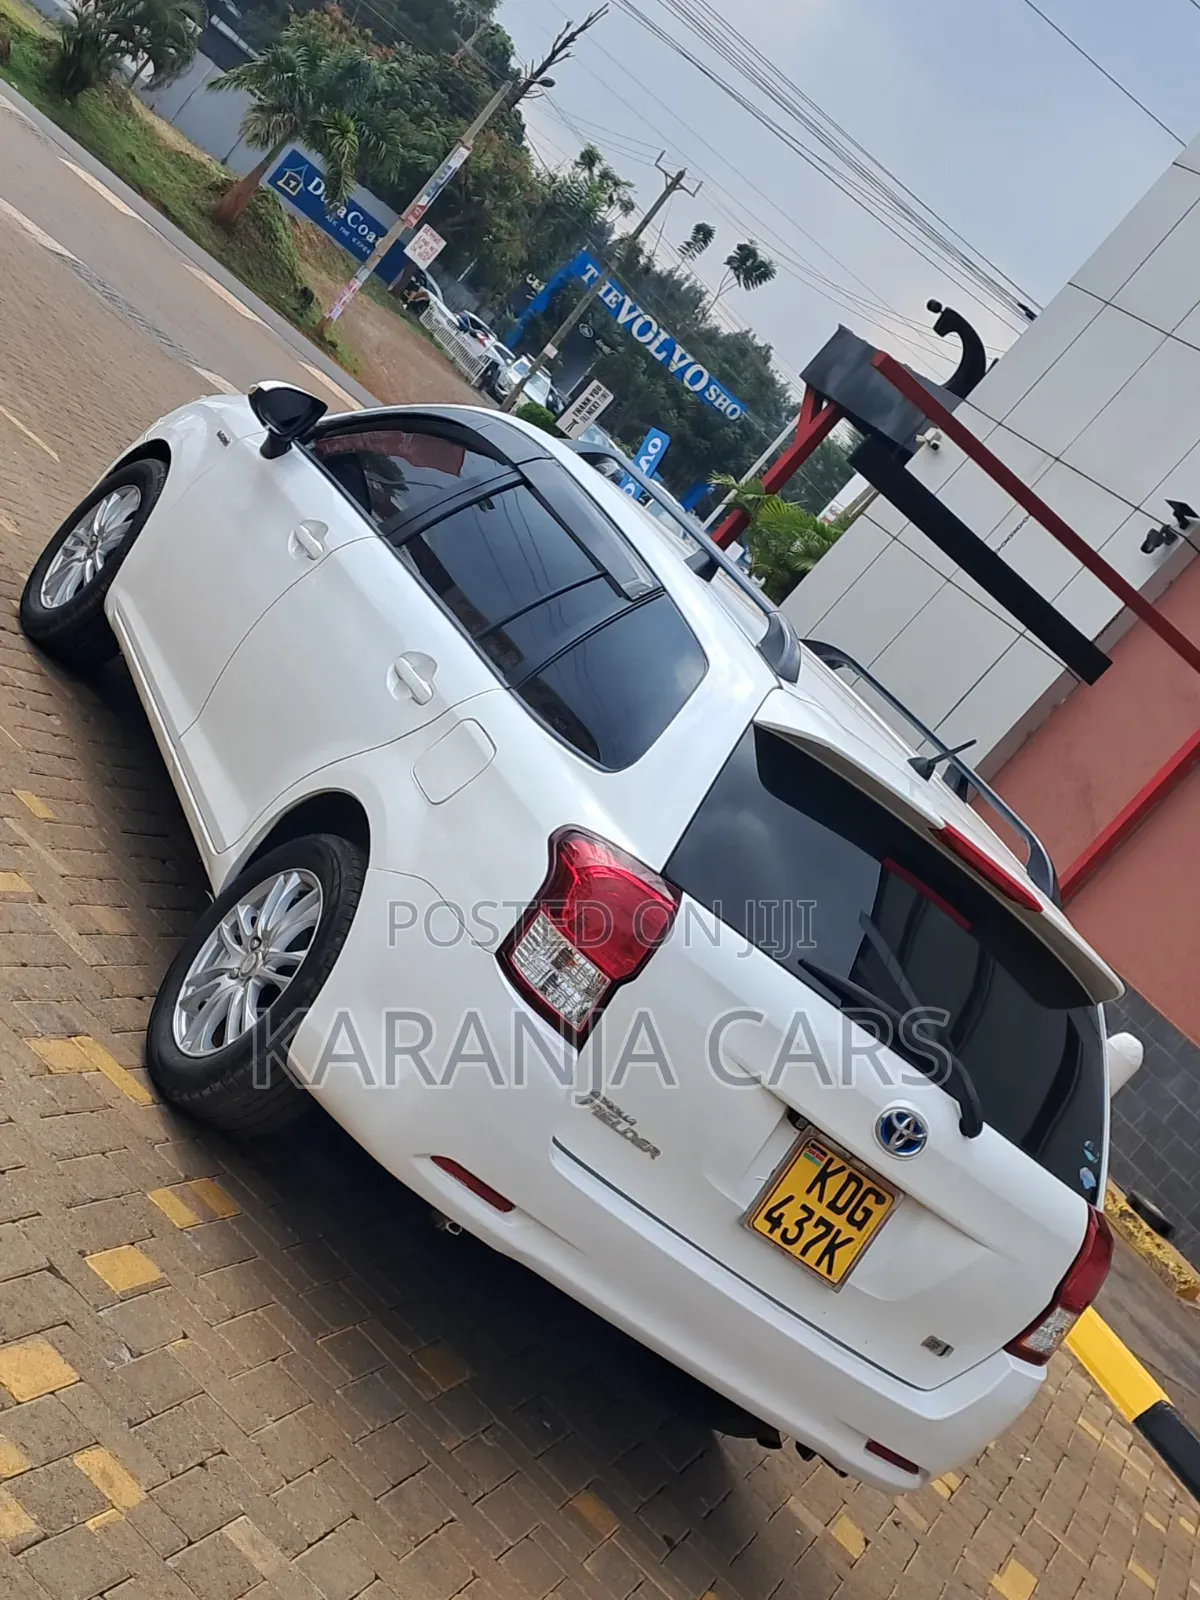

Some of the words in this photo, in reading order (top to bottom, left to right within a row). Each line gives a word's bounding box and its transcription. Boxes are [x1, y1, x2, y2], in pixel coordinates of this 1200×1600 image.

[617, 294, 710, 392] VOLVO
[705, 384, 744, 422] SHO
[572, 396, 592, 417] THANK
[589, 384, 603, 398] YOU
[586, 400, 601, 416] NEXT
[805, 1156, 887, 1232] KDG
[763, 1194, 855, 1276] 437K
